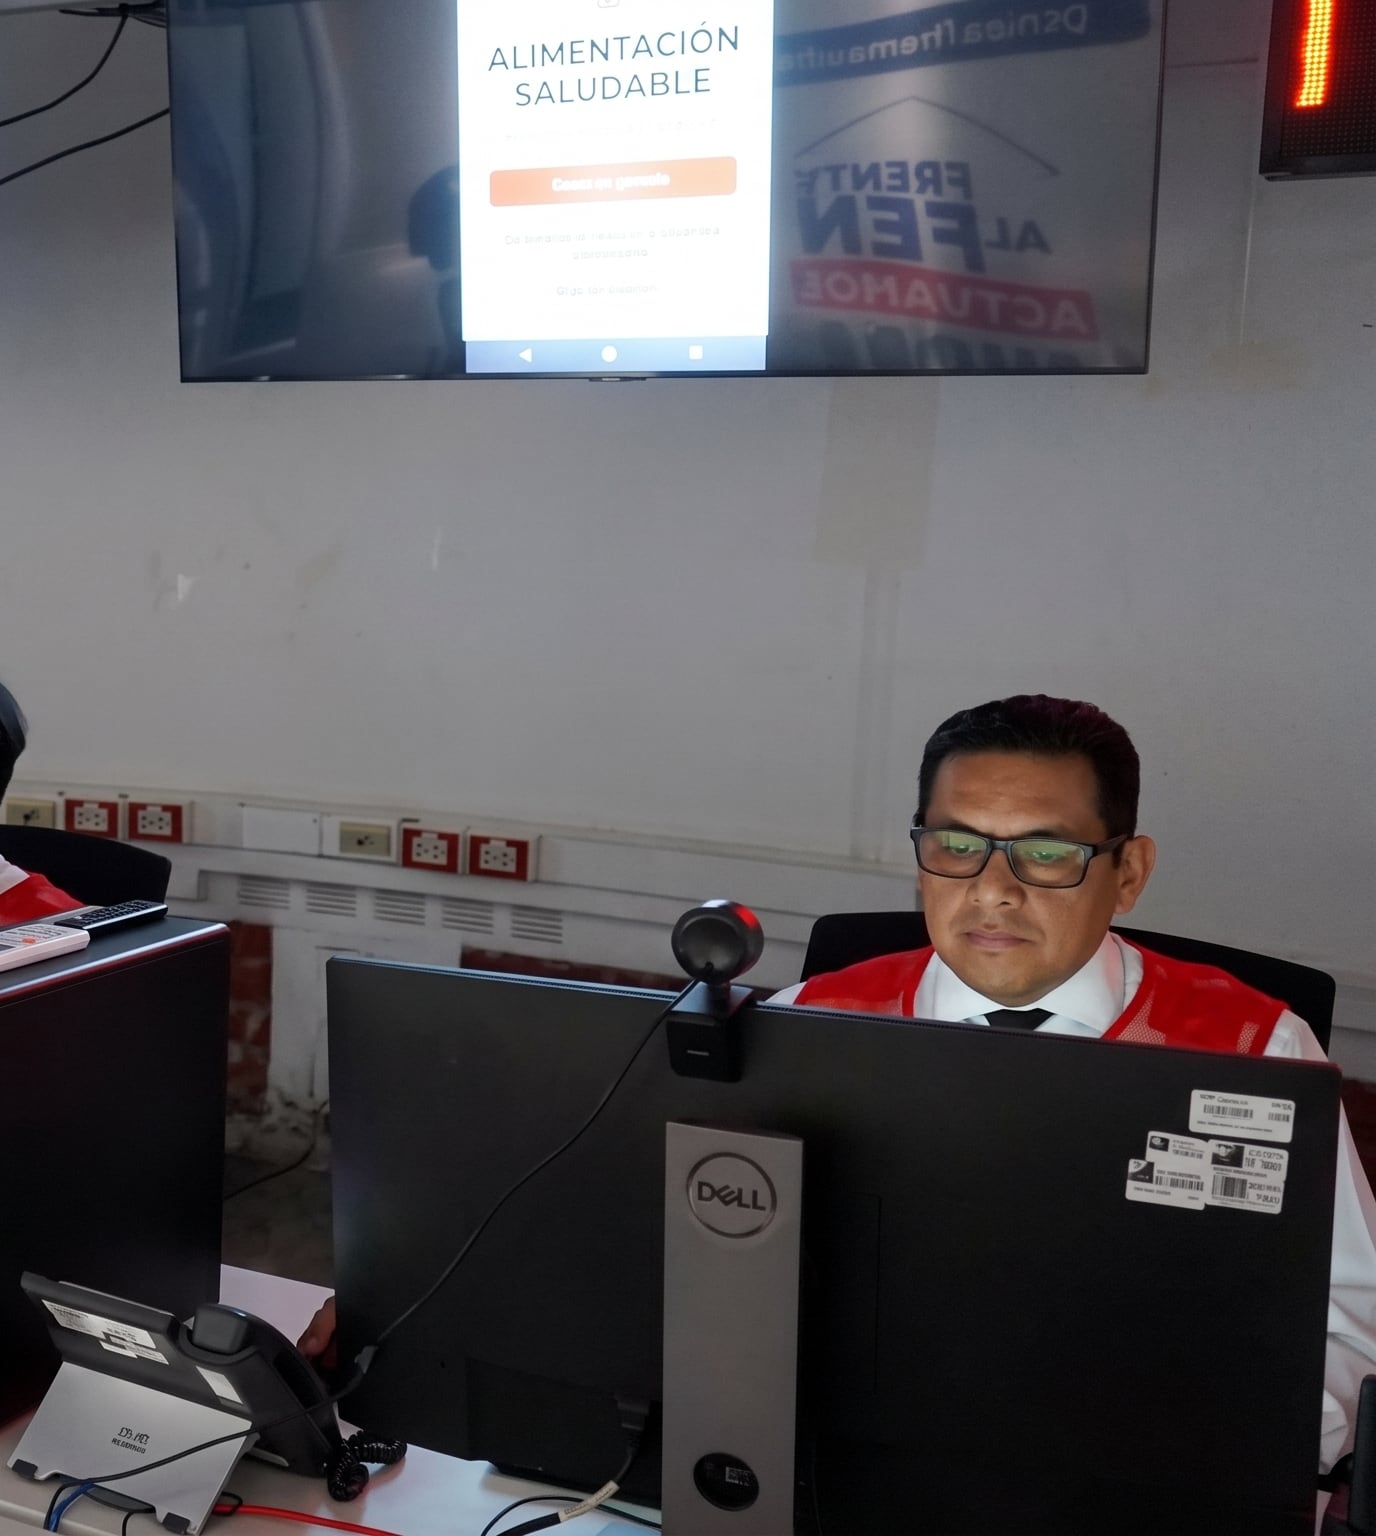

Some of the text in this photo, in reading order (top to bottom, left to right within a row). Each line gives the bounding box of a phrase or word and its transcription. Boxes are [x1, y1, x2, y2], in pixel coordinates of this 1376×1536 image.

[488, 21, 739, 72] ALIMENTACIÓN
[515, 68, 711, 107] SALUDABLE
[697, 1180, 766, 1211] DELL
